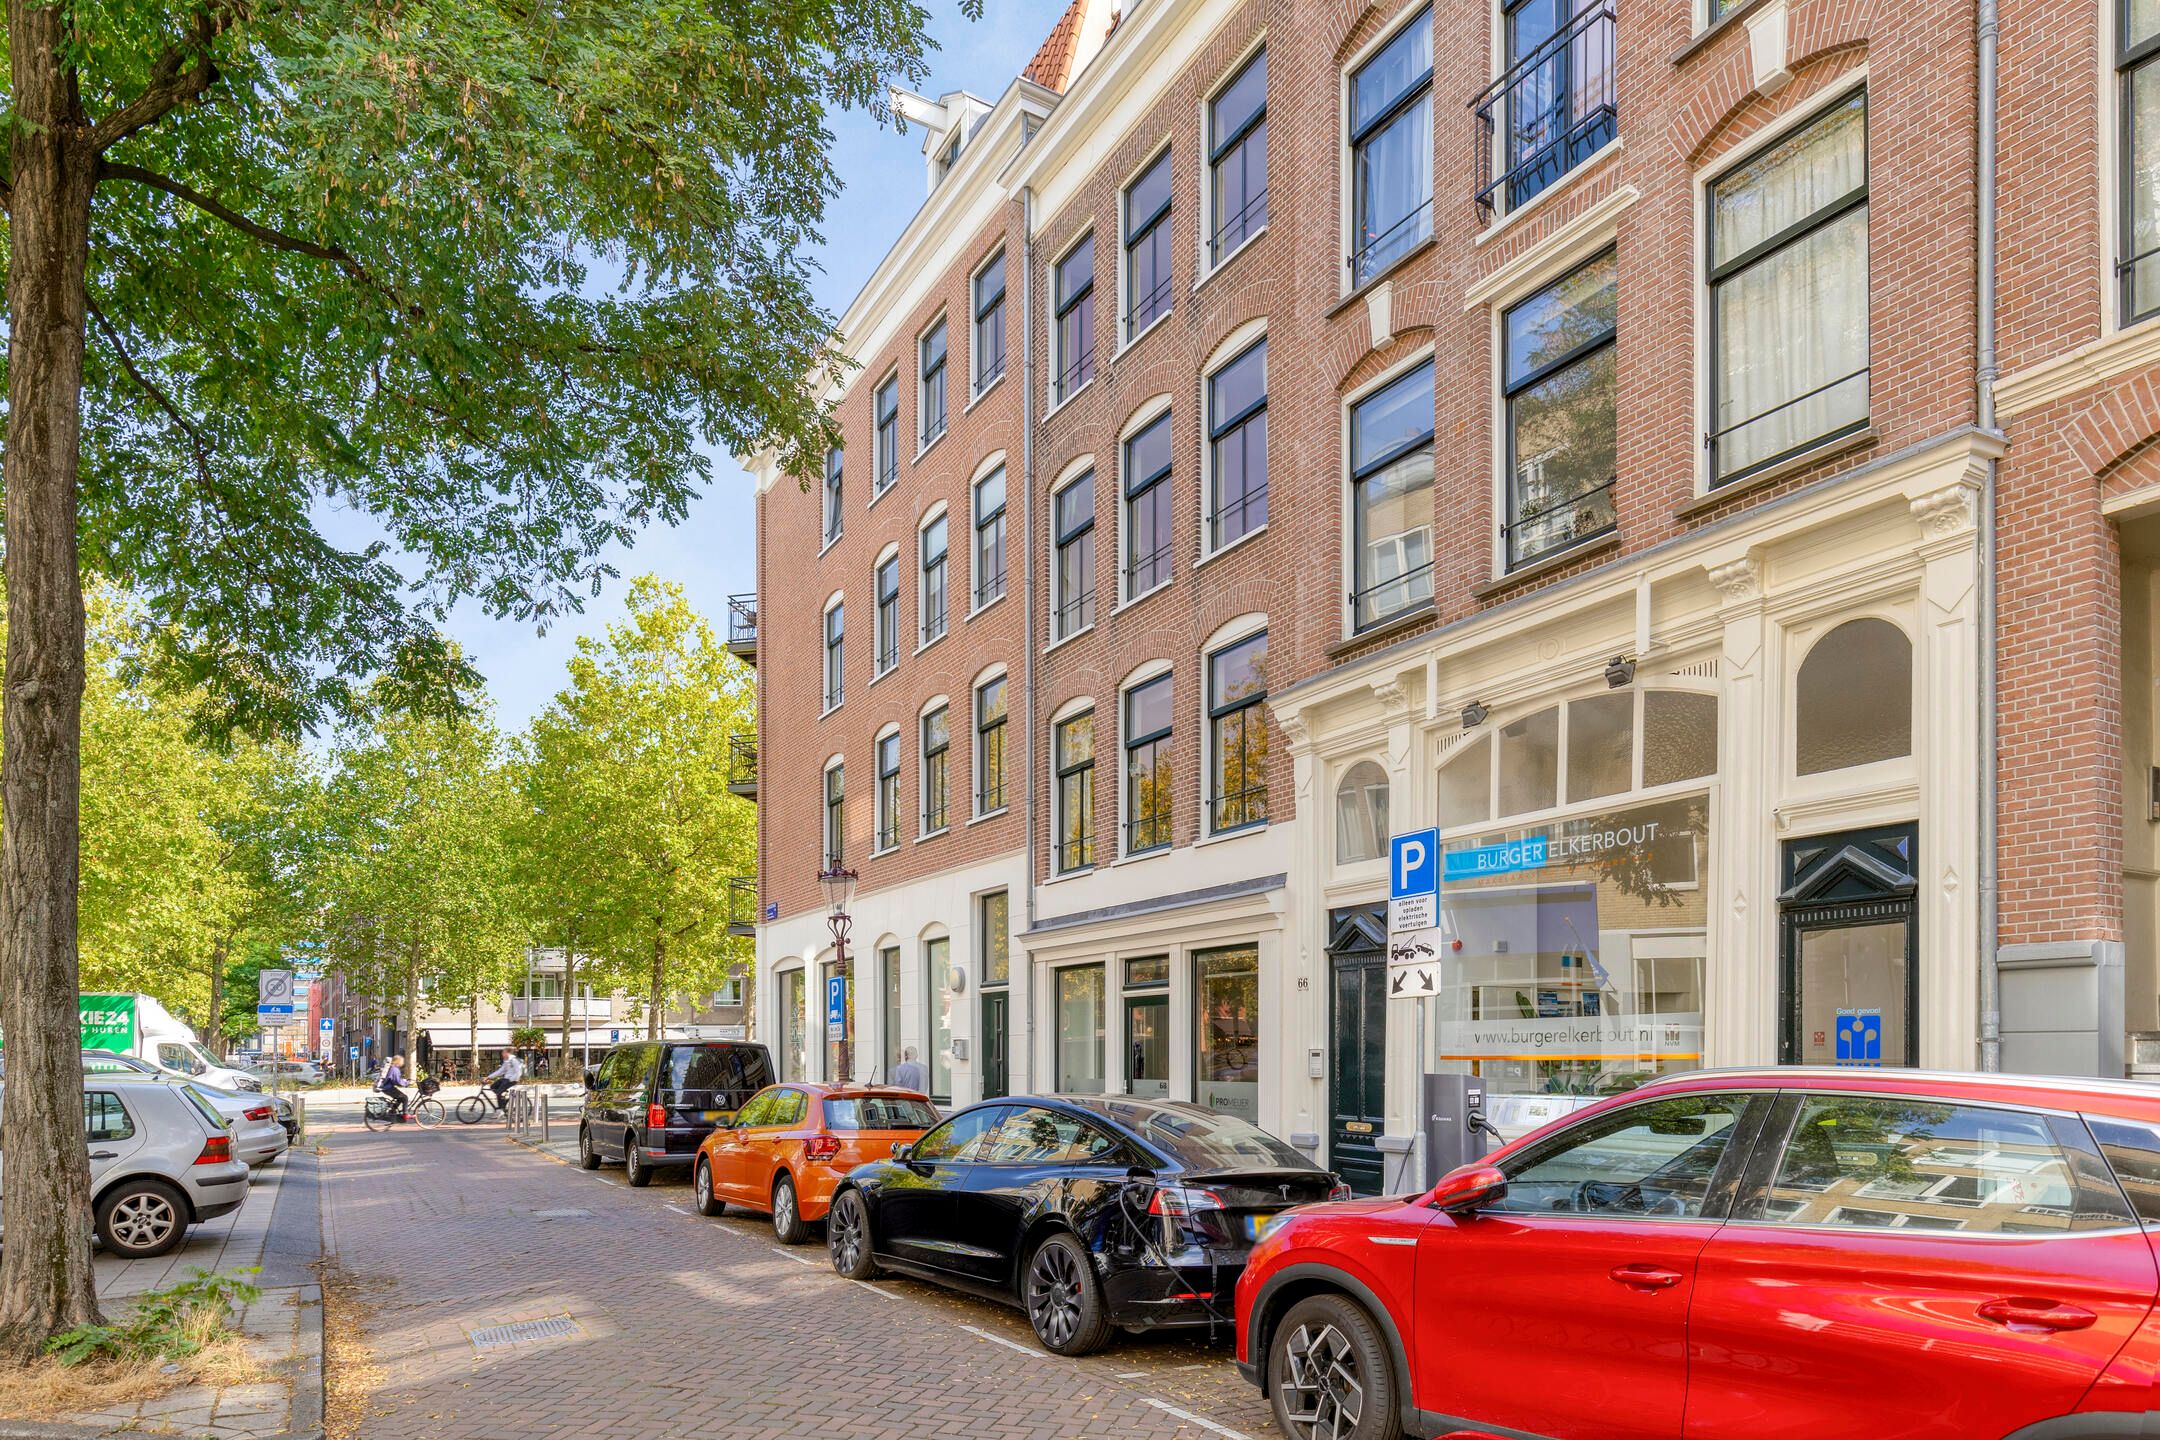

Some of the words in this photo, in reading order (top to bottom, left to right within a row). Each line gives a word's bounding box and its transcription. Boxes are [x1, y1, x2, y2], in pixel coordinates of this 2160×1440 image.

[1478, 843, 1543, 870] BURGER
[1549, 822, 1659, 858] ELKERBOUT
[1401, 841, 1426, 890] P
[1398, 899, 1415, 907] alleen
[1398, 912, 1428, 922] elektrische
[1399, 920, 1428, 929] voertuigen
[1297, 977, 1309, 988] 66
[831, 981, 840, 1005] P
[1836, 1007, 1855, 1015] Goed
[1857, 1007, 1881, 1016] gevoel
